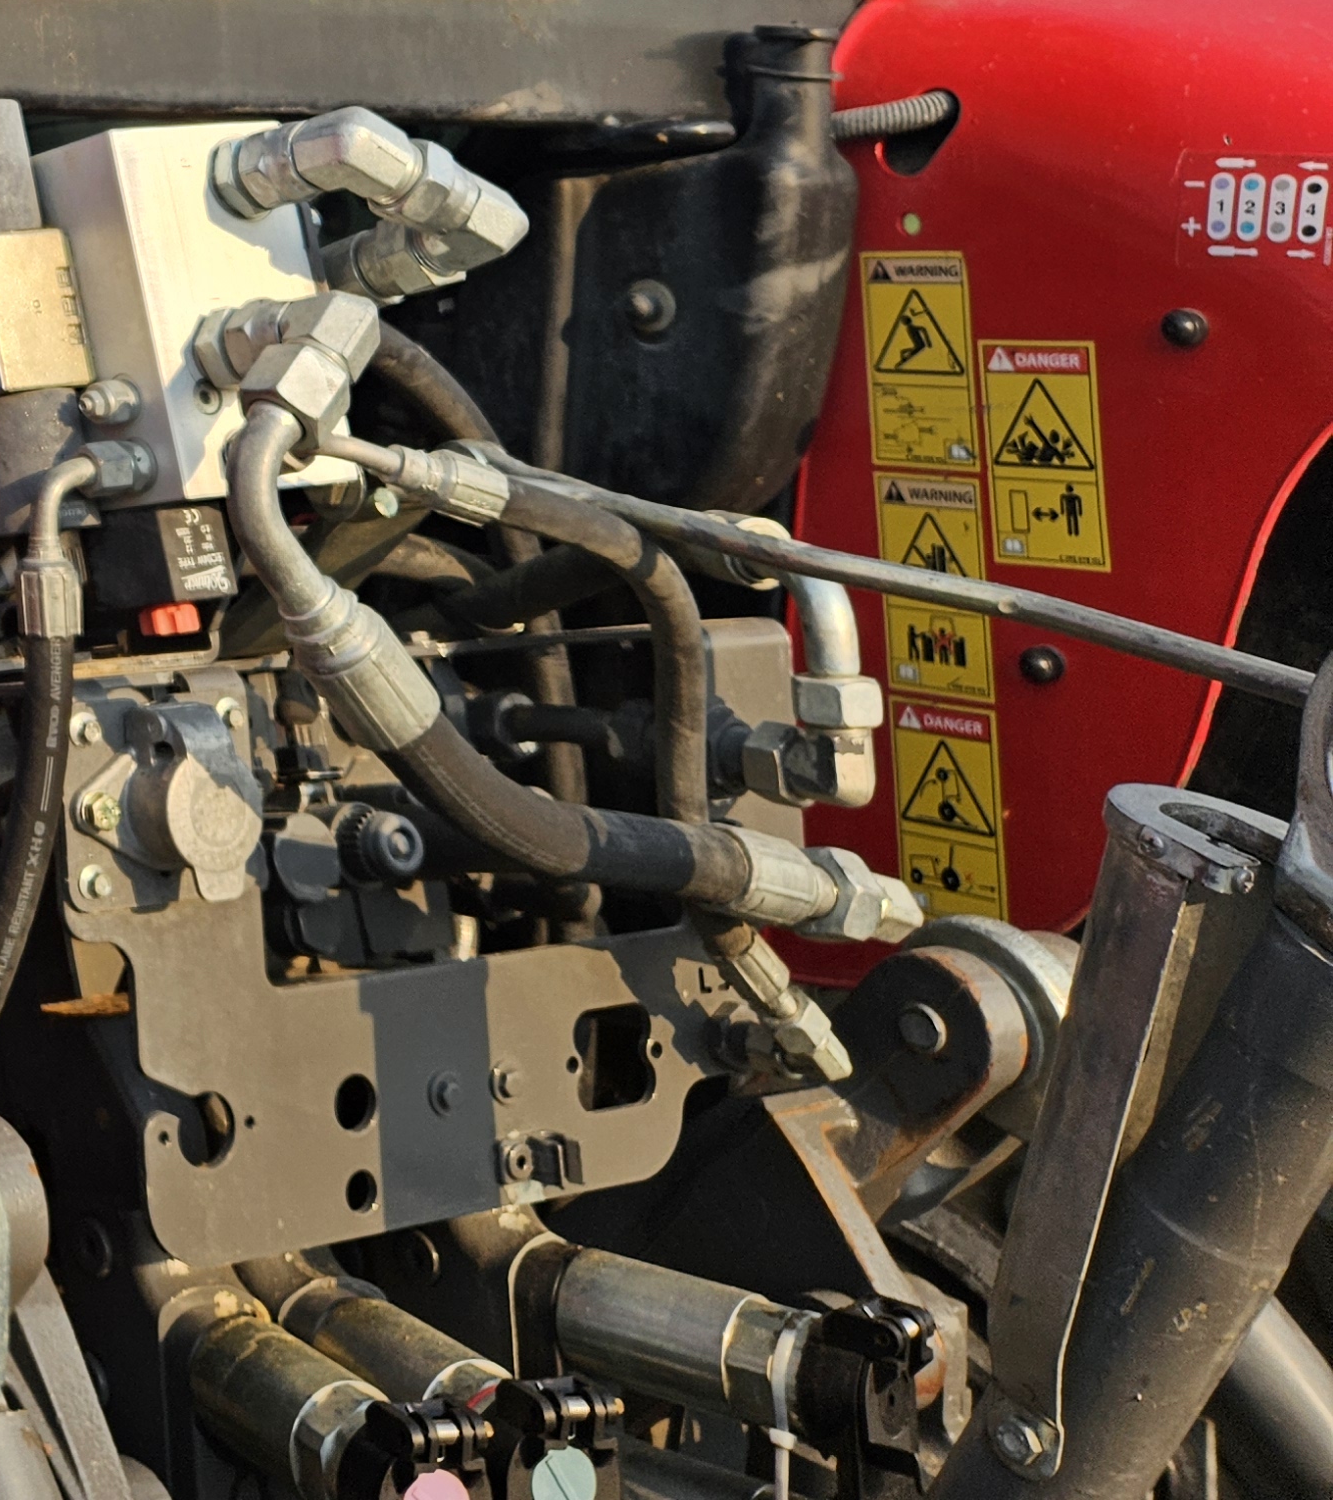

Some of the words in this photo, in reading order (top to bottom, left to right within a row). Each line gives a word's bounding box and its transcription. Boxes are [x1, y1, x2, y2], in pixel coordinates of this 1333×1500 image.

[1215, 199, 1225, 215] 1
[1243, 199, 1256, 216] 2
[1274, 201, 1286, 216] 3
[1305, 202, 1317, 217] 4
[893, 264, 959, 277] WARNING
[1014, 351, 1081, 370] DANGER
[907, 485, 974, 505] WARNING
[922, 712, 983, 736] DANGER
[8, 869, 36, 935] RESISTANT
[50, 638, 62, 701] AVENGER
